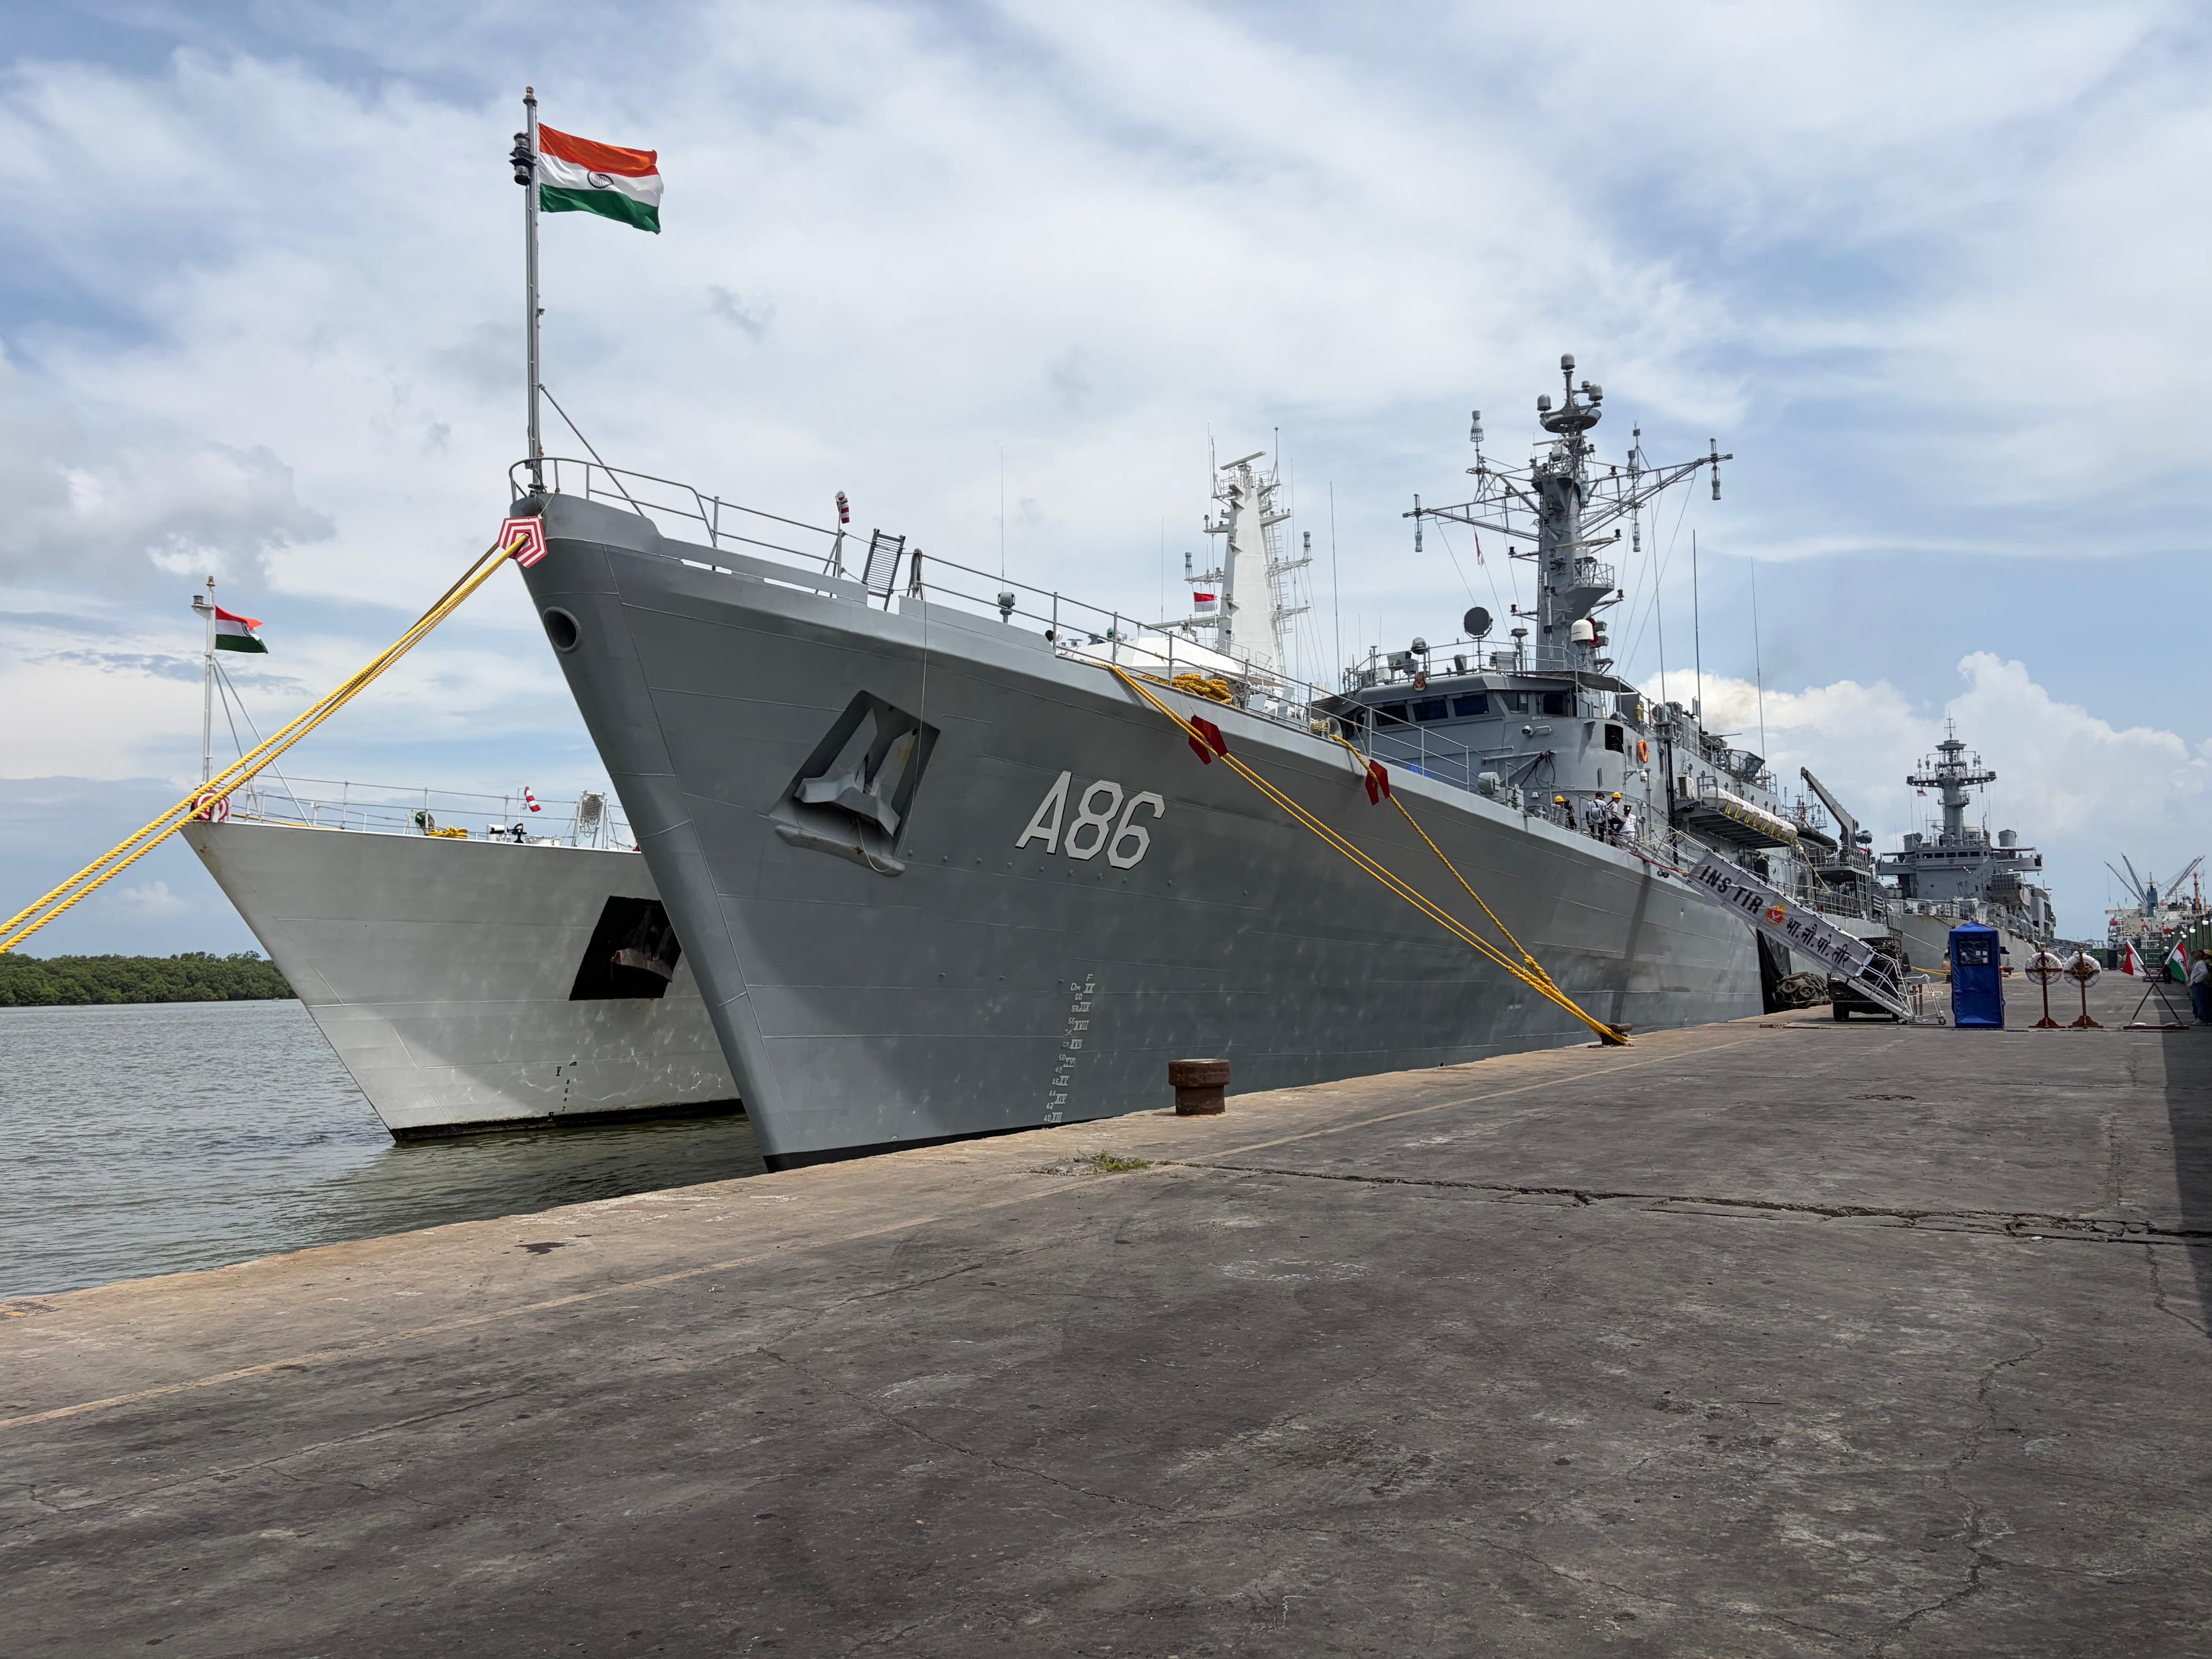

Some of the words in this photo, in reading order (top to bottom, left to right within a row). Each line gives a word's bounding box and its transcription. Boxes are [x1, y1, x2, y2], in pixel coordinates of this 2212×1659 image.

[1015, 770, 1165, 870] A86
[1699, 865, 1732, 893] INS
[1733, 886, 1764, 915] TIR
[1083, 983, 1095, 993] XX
[1078, 1002, 1091, 1012] XIX
[1063, 1057, 1076, 1067] XVI
[1058, 1076, 1070, 1086] XV
[1054, 1093, 1068, 1104] XIV
[1051, 1112, 1063, 1122] XIII
